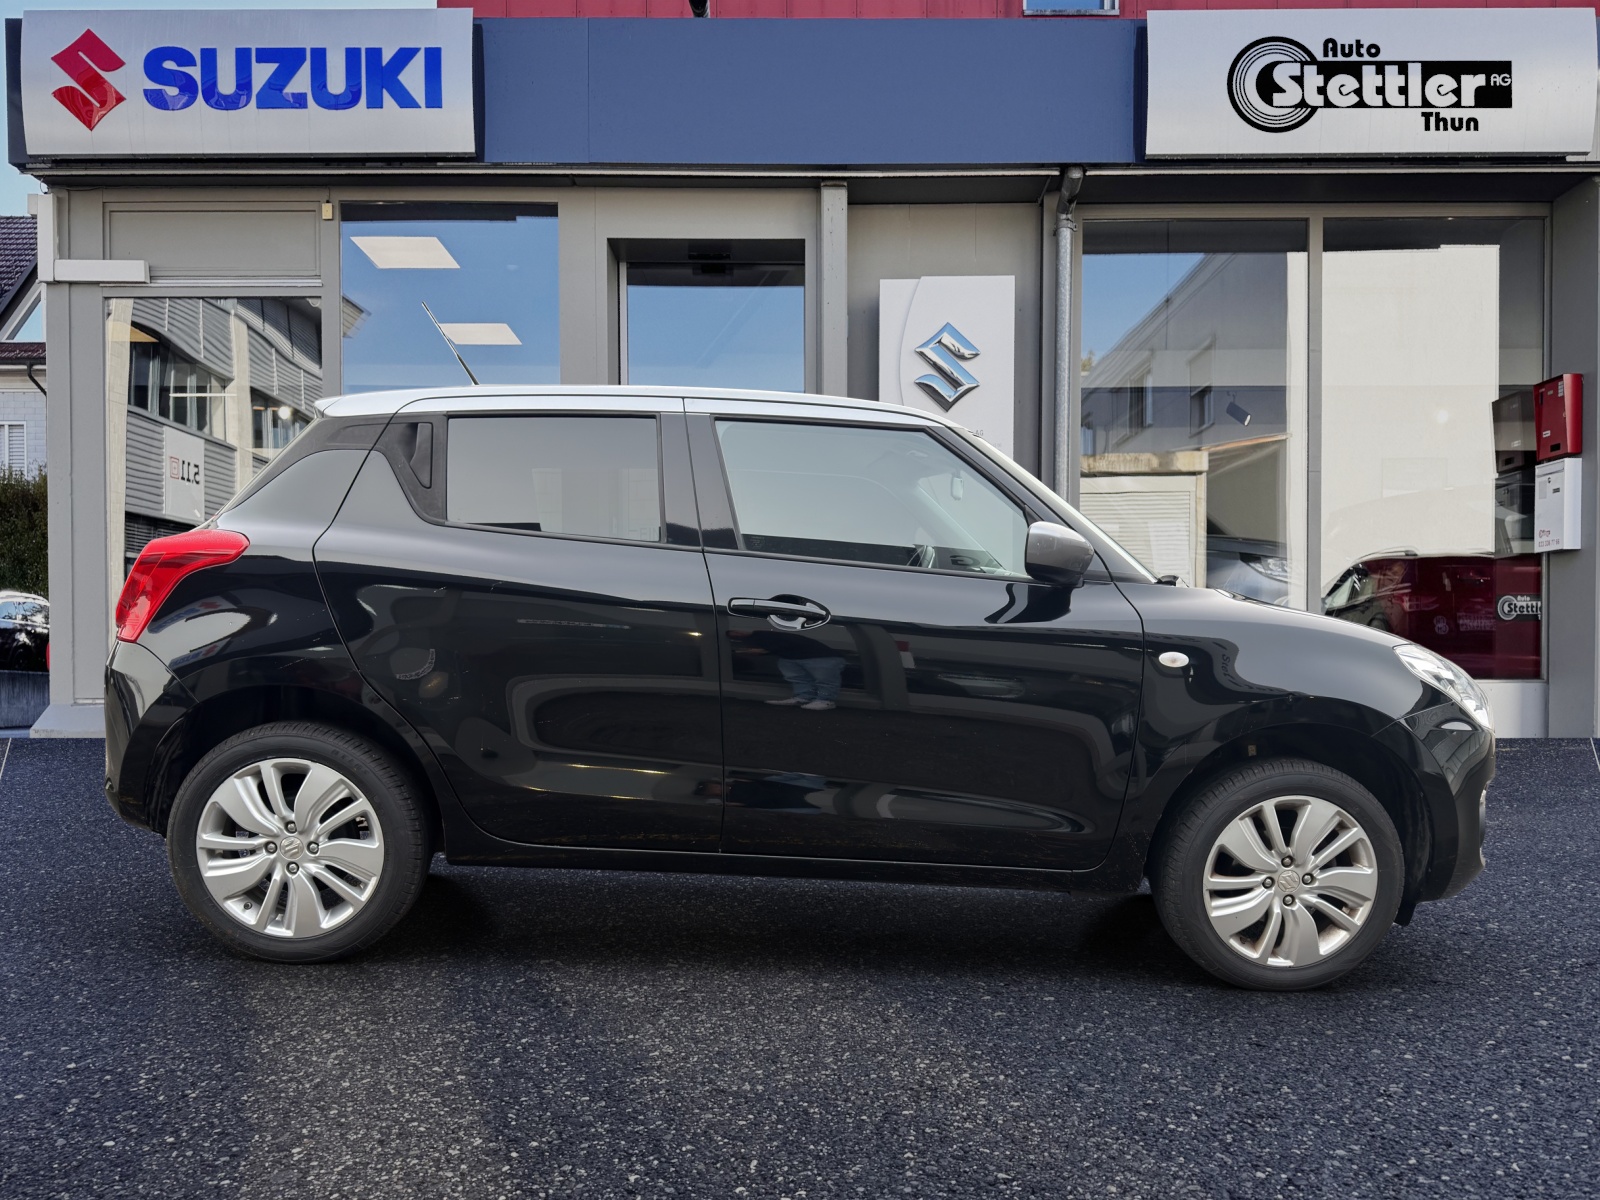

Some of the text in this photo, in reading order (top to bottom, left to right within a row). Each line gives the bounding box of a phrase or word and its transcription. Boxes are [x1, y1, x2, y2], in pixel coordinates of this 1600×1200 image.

[1322, 37, 1381, 58] Auto
[143, 46, 443, 111] SUZUKI
[1272, 62, 1512, 107] Stettler AG
[1421, 111, 1479, 131] Thun
